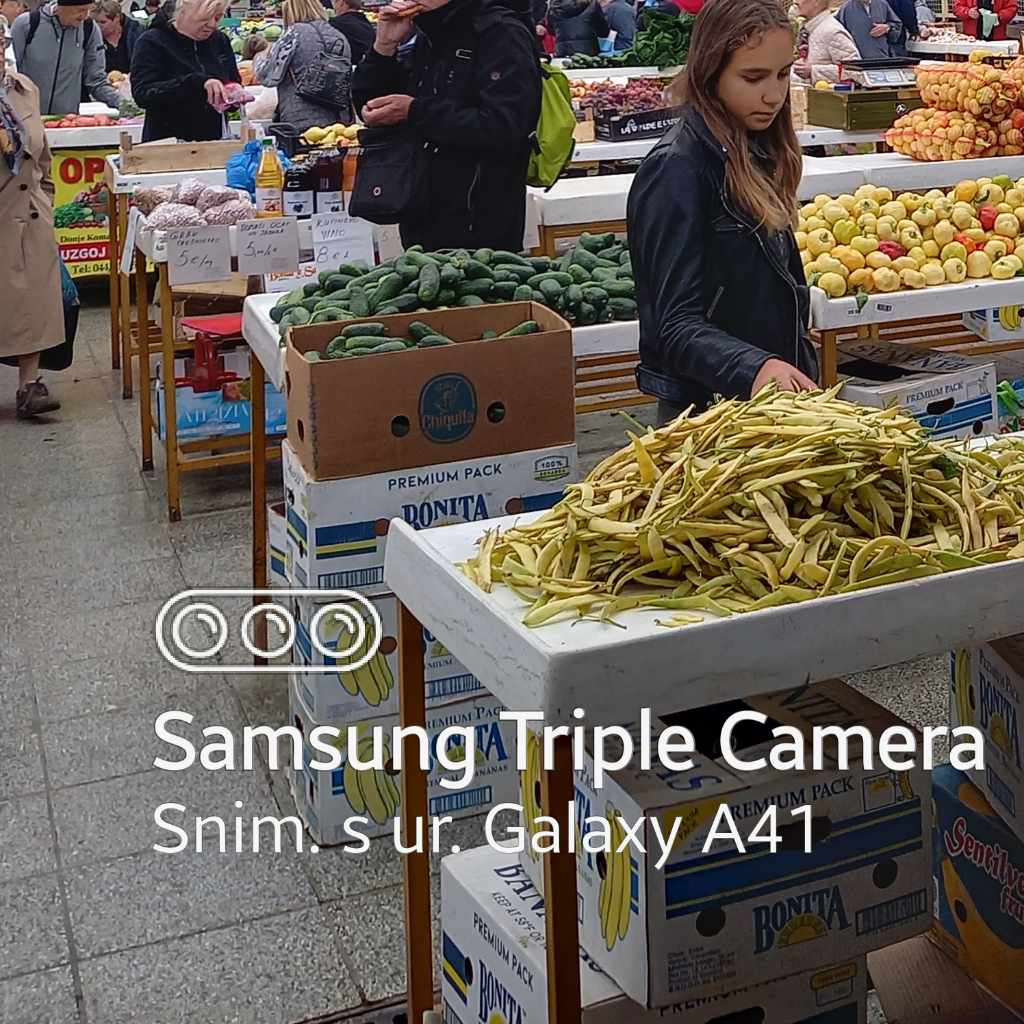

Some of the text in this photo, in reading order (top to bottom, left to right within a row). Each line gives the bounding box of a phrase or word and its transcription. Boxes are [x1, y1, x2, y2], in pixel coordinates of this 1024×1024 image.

[61, 247, 107, 261] UZGOJ
[905, 381, 964, 404] PREMIUM PACK
[388, 463, 503, 491] PREMIUM PACK
[979, 672, 1023, 770] BONITA
[811, 776, 855, 802] PACK
[752, 884, 852, 955] BONITA
[473, 911, 535, 993] PREMIUM PACK
